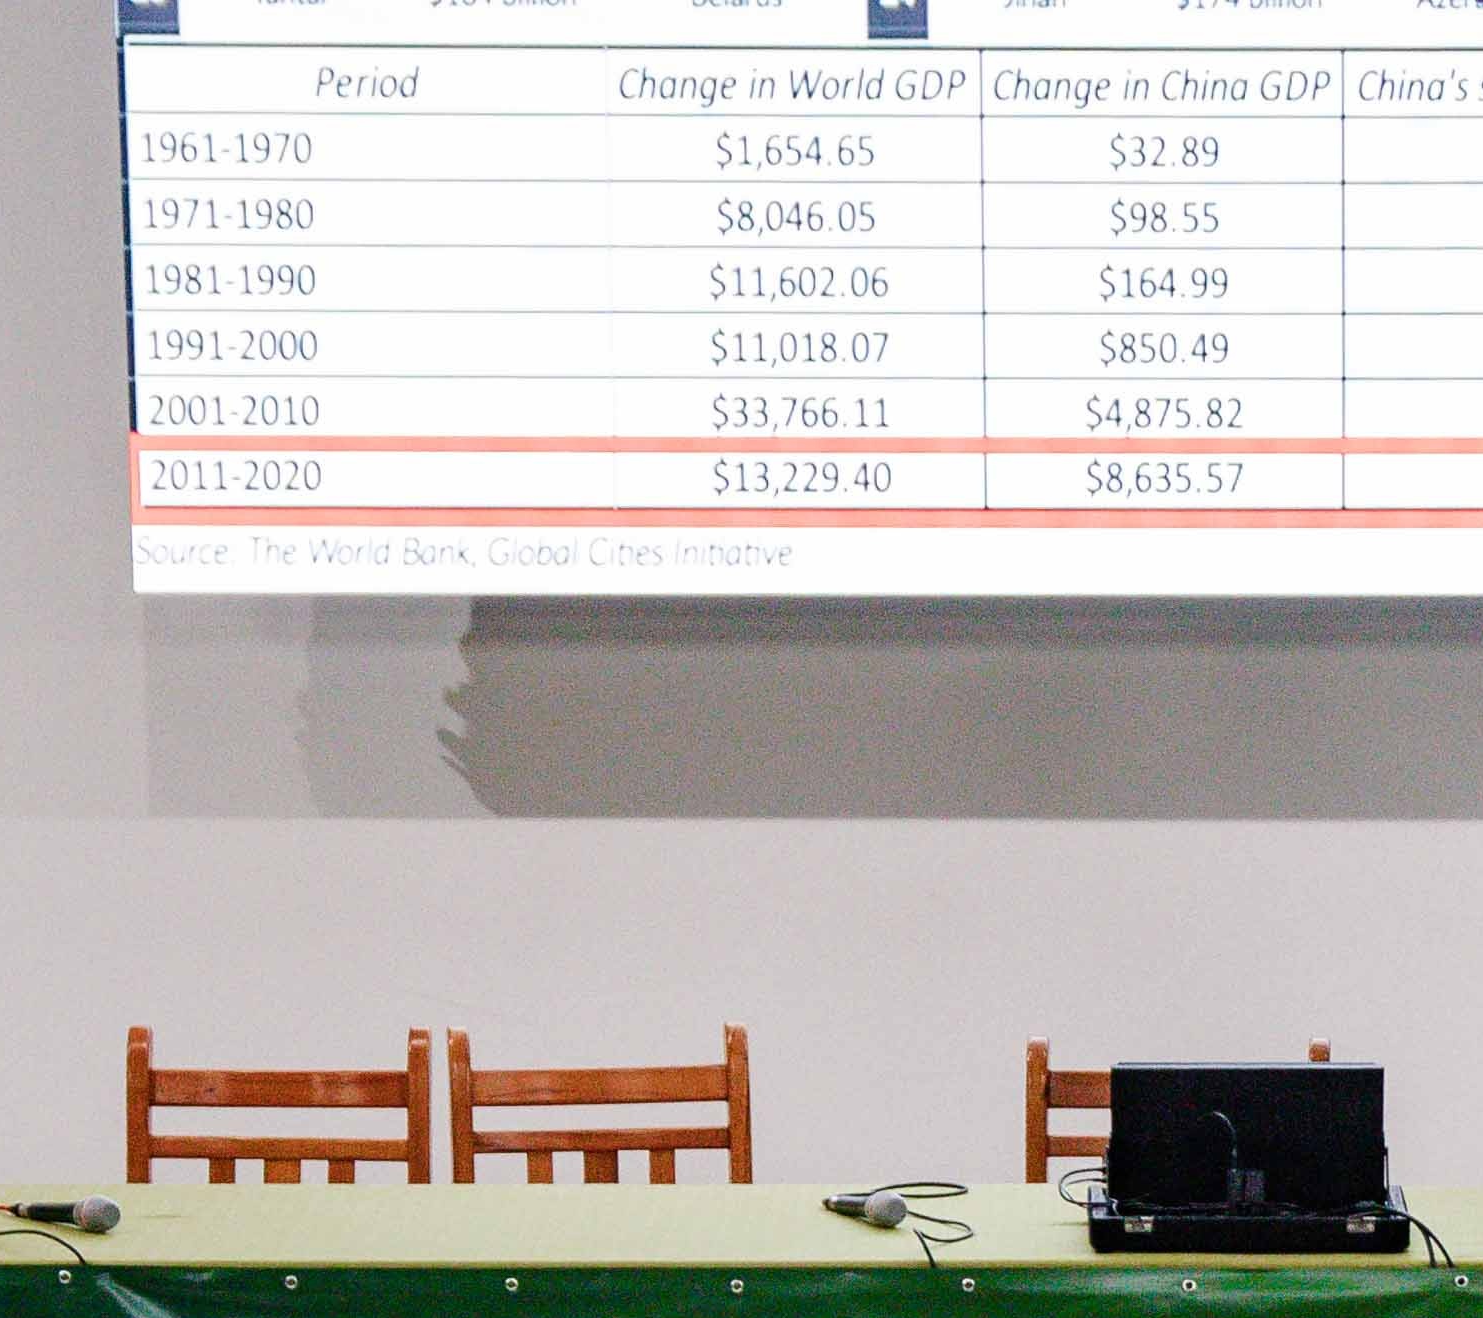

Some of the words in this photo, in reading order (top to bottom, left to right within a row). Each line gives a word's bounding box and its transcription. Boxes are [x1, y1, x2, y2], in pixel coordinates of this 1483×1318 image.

[314, 67, 420, 99] Period
[617, 68, 738, 107] Change
[747, 69, 777, 98] in
[787, 69, 886, 101] World
[893, 69, 968, 101] GDP
[991, 69, 1112, 109] Change
[1121, 69, 1151, 100] in
[1159, 70, 1249, 102] China
[1257, 71, 1332, 102] GDP
[1356, 69, 1469, 102] China's
[142, 132, 313, 164] 1961-1970
[714, 132, 876, 169] $1,654.65
[1108, 133, 1221, 171] $32.89
[145, 198, 315, 230] 1971-1980
[715, 198, 877, 235] $8,046.05
[1108, 199, 1221, 236] $98.55
[146, 264, 317, 296] 1981-1990
[708, 263, 890, 301] $11,602.06
[1097, 264, 1230, 302] $164.99
[149, 329, 319, 361] 1991-2000
[709, 329, 890, 367] $11,018.07
[1098, 330, 1230, 367] $850.49
[148, 395, 321, 426] 2001-2010
[710, 393, 889, 431] $33,766.11
[1084, 395, 1243, 431] $4,875.82
[150, 460, 323, 491] 2011-2020
[711, 458, 893, 496] $13,229.40
[1084, 459, 1245, 496] $8,635.57
[248, 536, 297, 567] The
[308, 536, 390, 567] World
[489, 536, 579, 567] Global
[588, 536, 664, 567] Cities
[675, 536, 793, 567] Initiative
